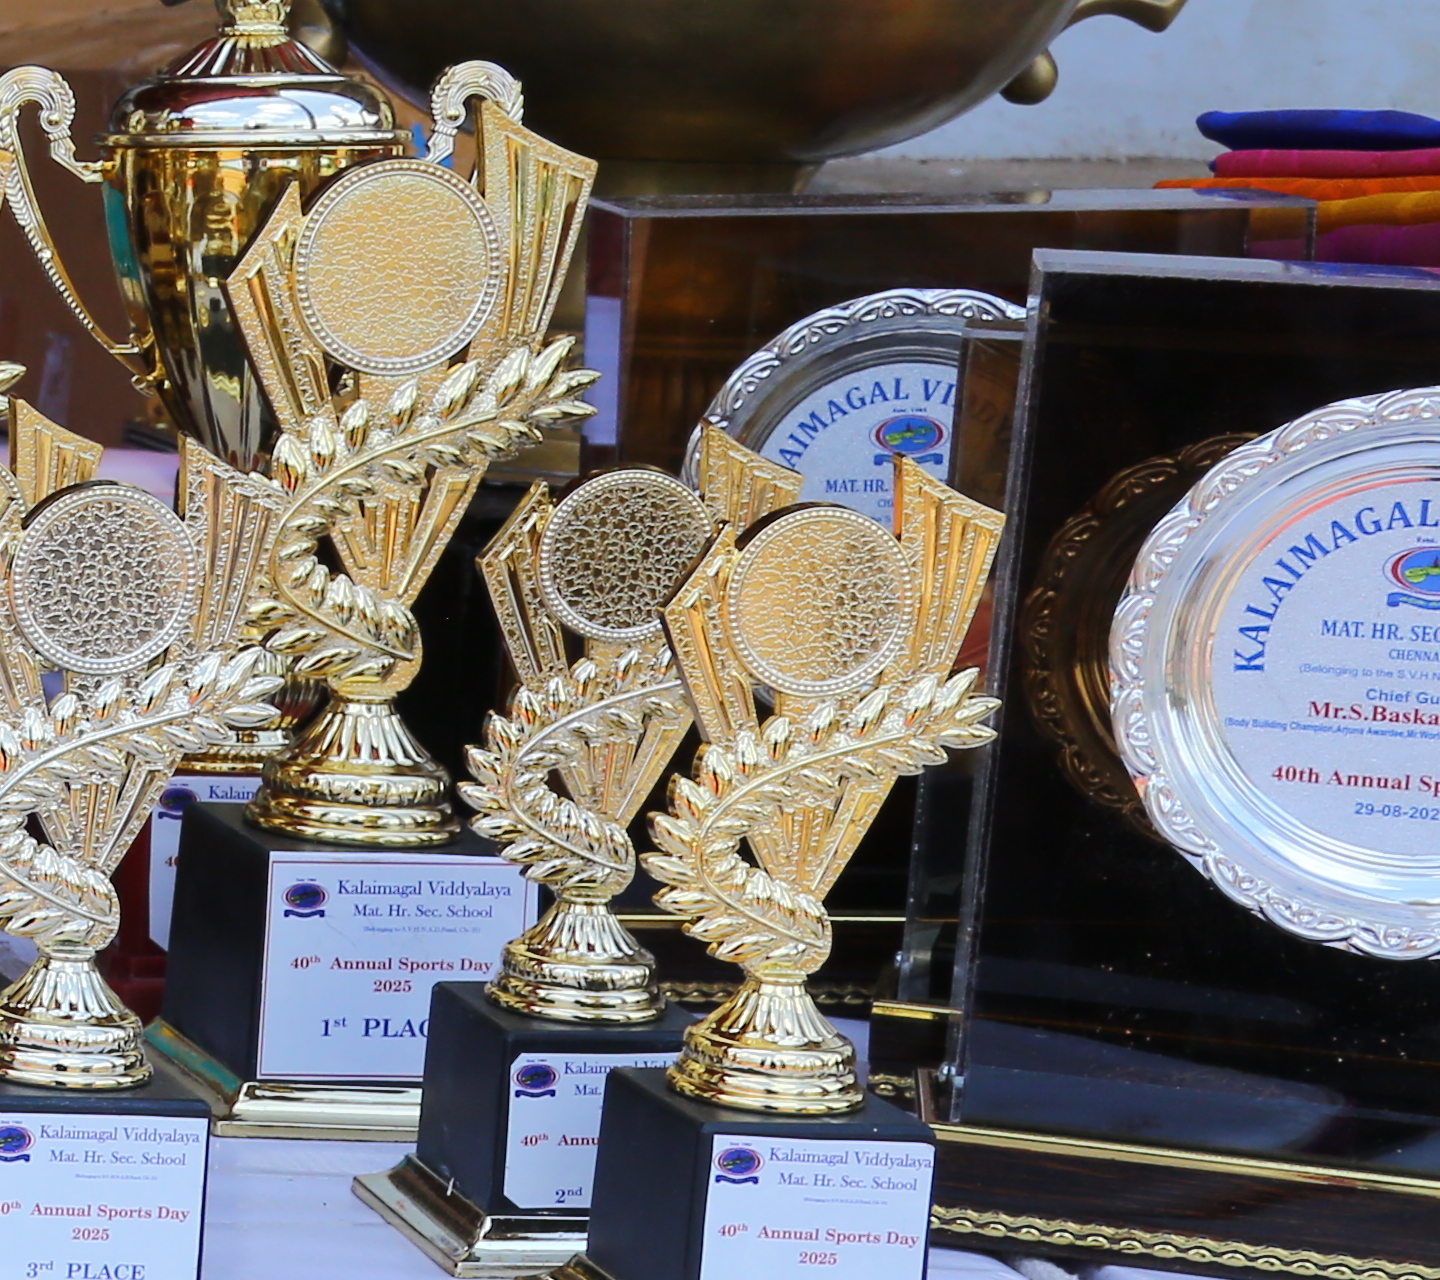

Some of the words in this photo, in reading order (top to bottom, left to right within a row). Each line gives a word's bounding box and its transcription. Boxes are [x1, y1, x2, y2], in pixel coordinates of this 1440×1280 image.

[778, 378, 909, 468] AIMAGAL
[826, 479, 860, 493] MAT.
[863, 480, 889, 492] HR.
[1234, 499, 1438, 671] KALAIMAGAL
[1321, 620, 1365, 638] MAT.
[1372, 623, 1403, 640] HR.
[1363, 668, 1373, 676] to
[1376, 669, 1393, 678] the
[1366, 688, 1411, 704] Chief
[1272, 765, 1320, 784] 40th
[1327, 770, 1410, 791] Annual
[338, 880, 422, 898] Kalaimagal
[428, 881, 510, 899] Viddyalaya
[354, 904, 382, 916] Mat.
[389, 904, 410, 916] Hr.
[415, 905, 442, 917] Sec.
[446, 905, 492, 917] School
[291, 956, 320, 969] 40th
[331, 957, 392, 970] Annual
[399, 958, 453, 973] Sports
[460, 958, 493, 974] Day
[374, 980, 411, 992] 2025
[322, 1017, 346, 1036] 1st
[362, 1017, 430, 1039] PLAC
[575, 1084, 601, 1095] Mat.
[40, 1125, 118, 1143] Kalaimagal
[123, 1127, 200, 1146] Viddyalaya
[521, 1134, 548, 1146] 40th
[558, 1135, 599, 1147] Annu
[49, 1149, 79, 1162] Mat.
[84, 1150, 106, 1163] Hr.
[110, 1151, 136, 1164] Sec.
[141, 1152, 186, 1166] School
[769, 1147, 849, 1167] Kalaimagal
[854, 1151, 933, 1170] Viddyalaya
[778, 1172, 808, 1185] Mat.
[813, 1174, 836, 1187] Hr.
[840, 1175, 867, 1188] Sec.
[871, 1176, 917, 1191] School
[555, 1187, 582, 1203] 2nd
[30, 1202, 91, 1217] Annual
[97, 1204, 152, 1221] Sports
[157, 1206, 190, 1223] Day
[72, 1228, 110, 1241] 2025
[718, 1223, 748, 1237] 40th
[757, 1225, 819, 1241] Annual
[825, 1229, 880, 1245] Sports
[886, 1231, 919, 1248] Day
[798, 1251, 837, 1265] 2025
[26, 1260, 53, 1278] 3rd
[67, 1263, 145, 1280] PLACE
